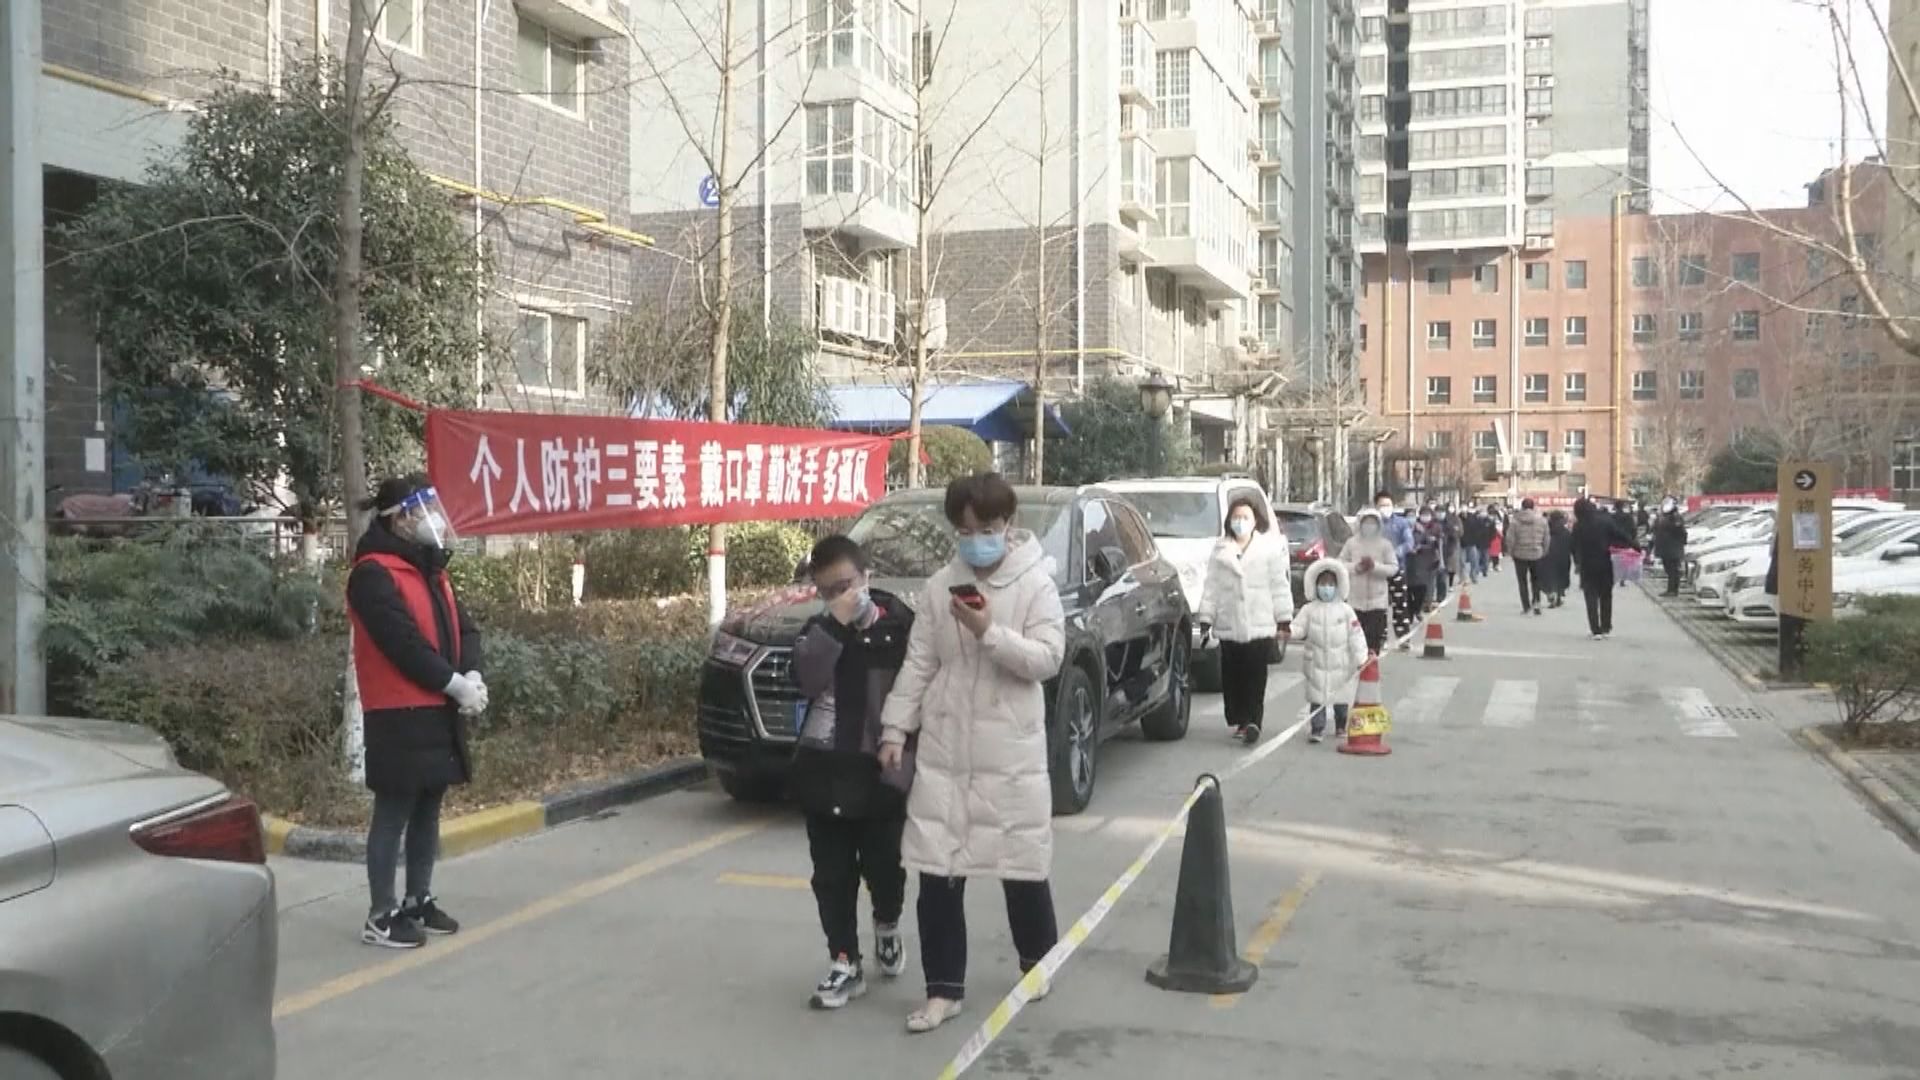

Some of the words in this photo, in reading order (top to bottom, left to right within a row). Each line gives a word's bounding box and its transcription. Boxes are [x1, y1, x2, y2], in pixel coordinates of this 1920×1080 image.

[469, 434, 687, 517] 个人防护三要素
